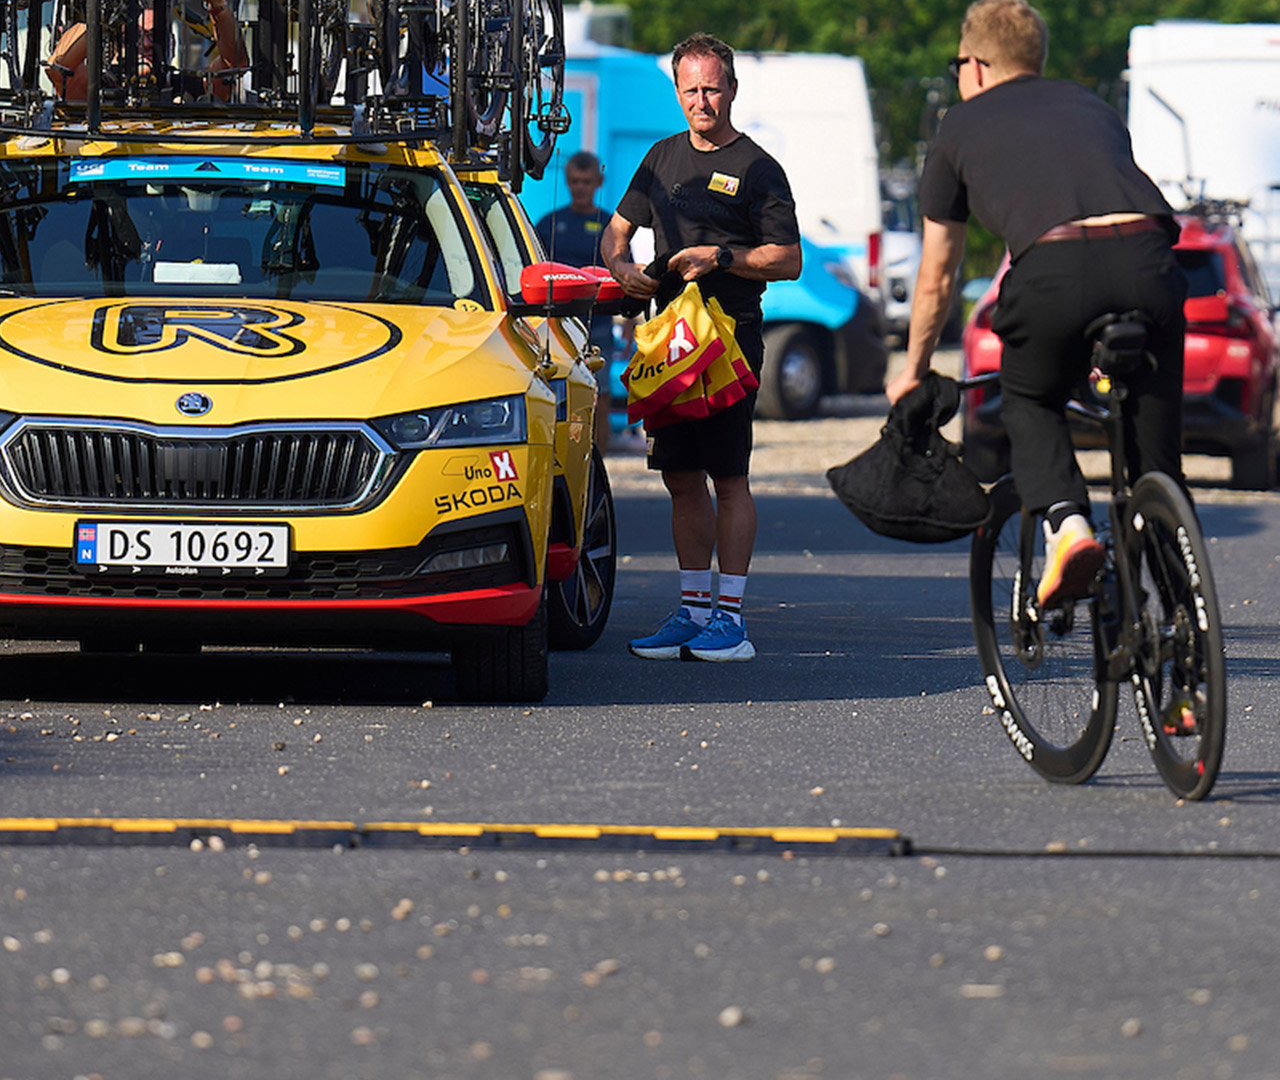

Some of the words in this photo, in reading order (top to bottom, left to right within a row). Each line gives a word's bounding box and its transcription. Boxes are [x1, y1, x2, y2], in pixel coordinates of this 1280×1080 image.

[128, 163, 169, 172] Team
[242, 164, 284, 174] Team
[464, 465, 492, 480] Uno
[492, 451, 516, 480] X
[81, 548, 92, 560] N
[109, 529, 152, 561] DS
[170, 530, 275, 563] 10692
